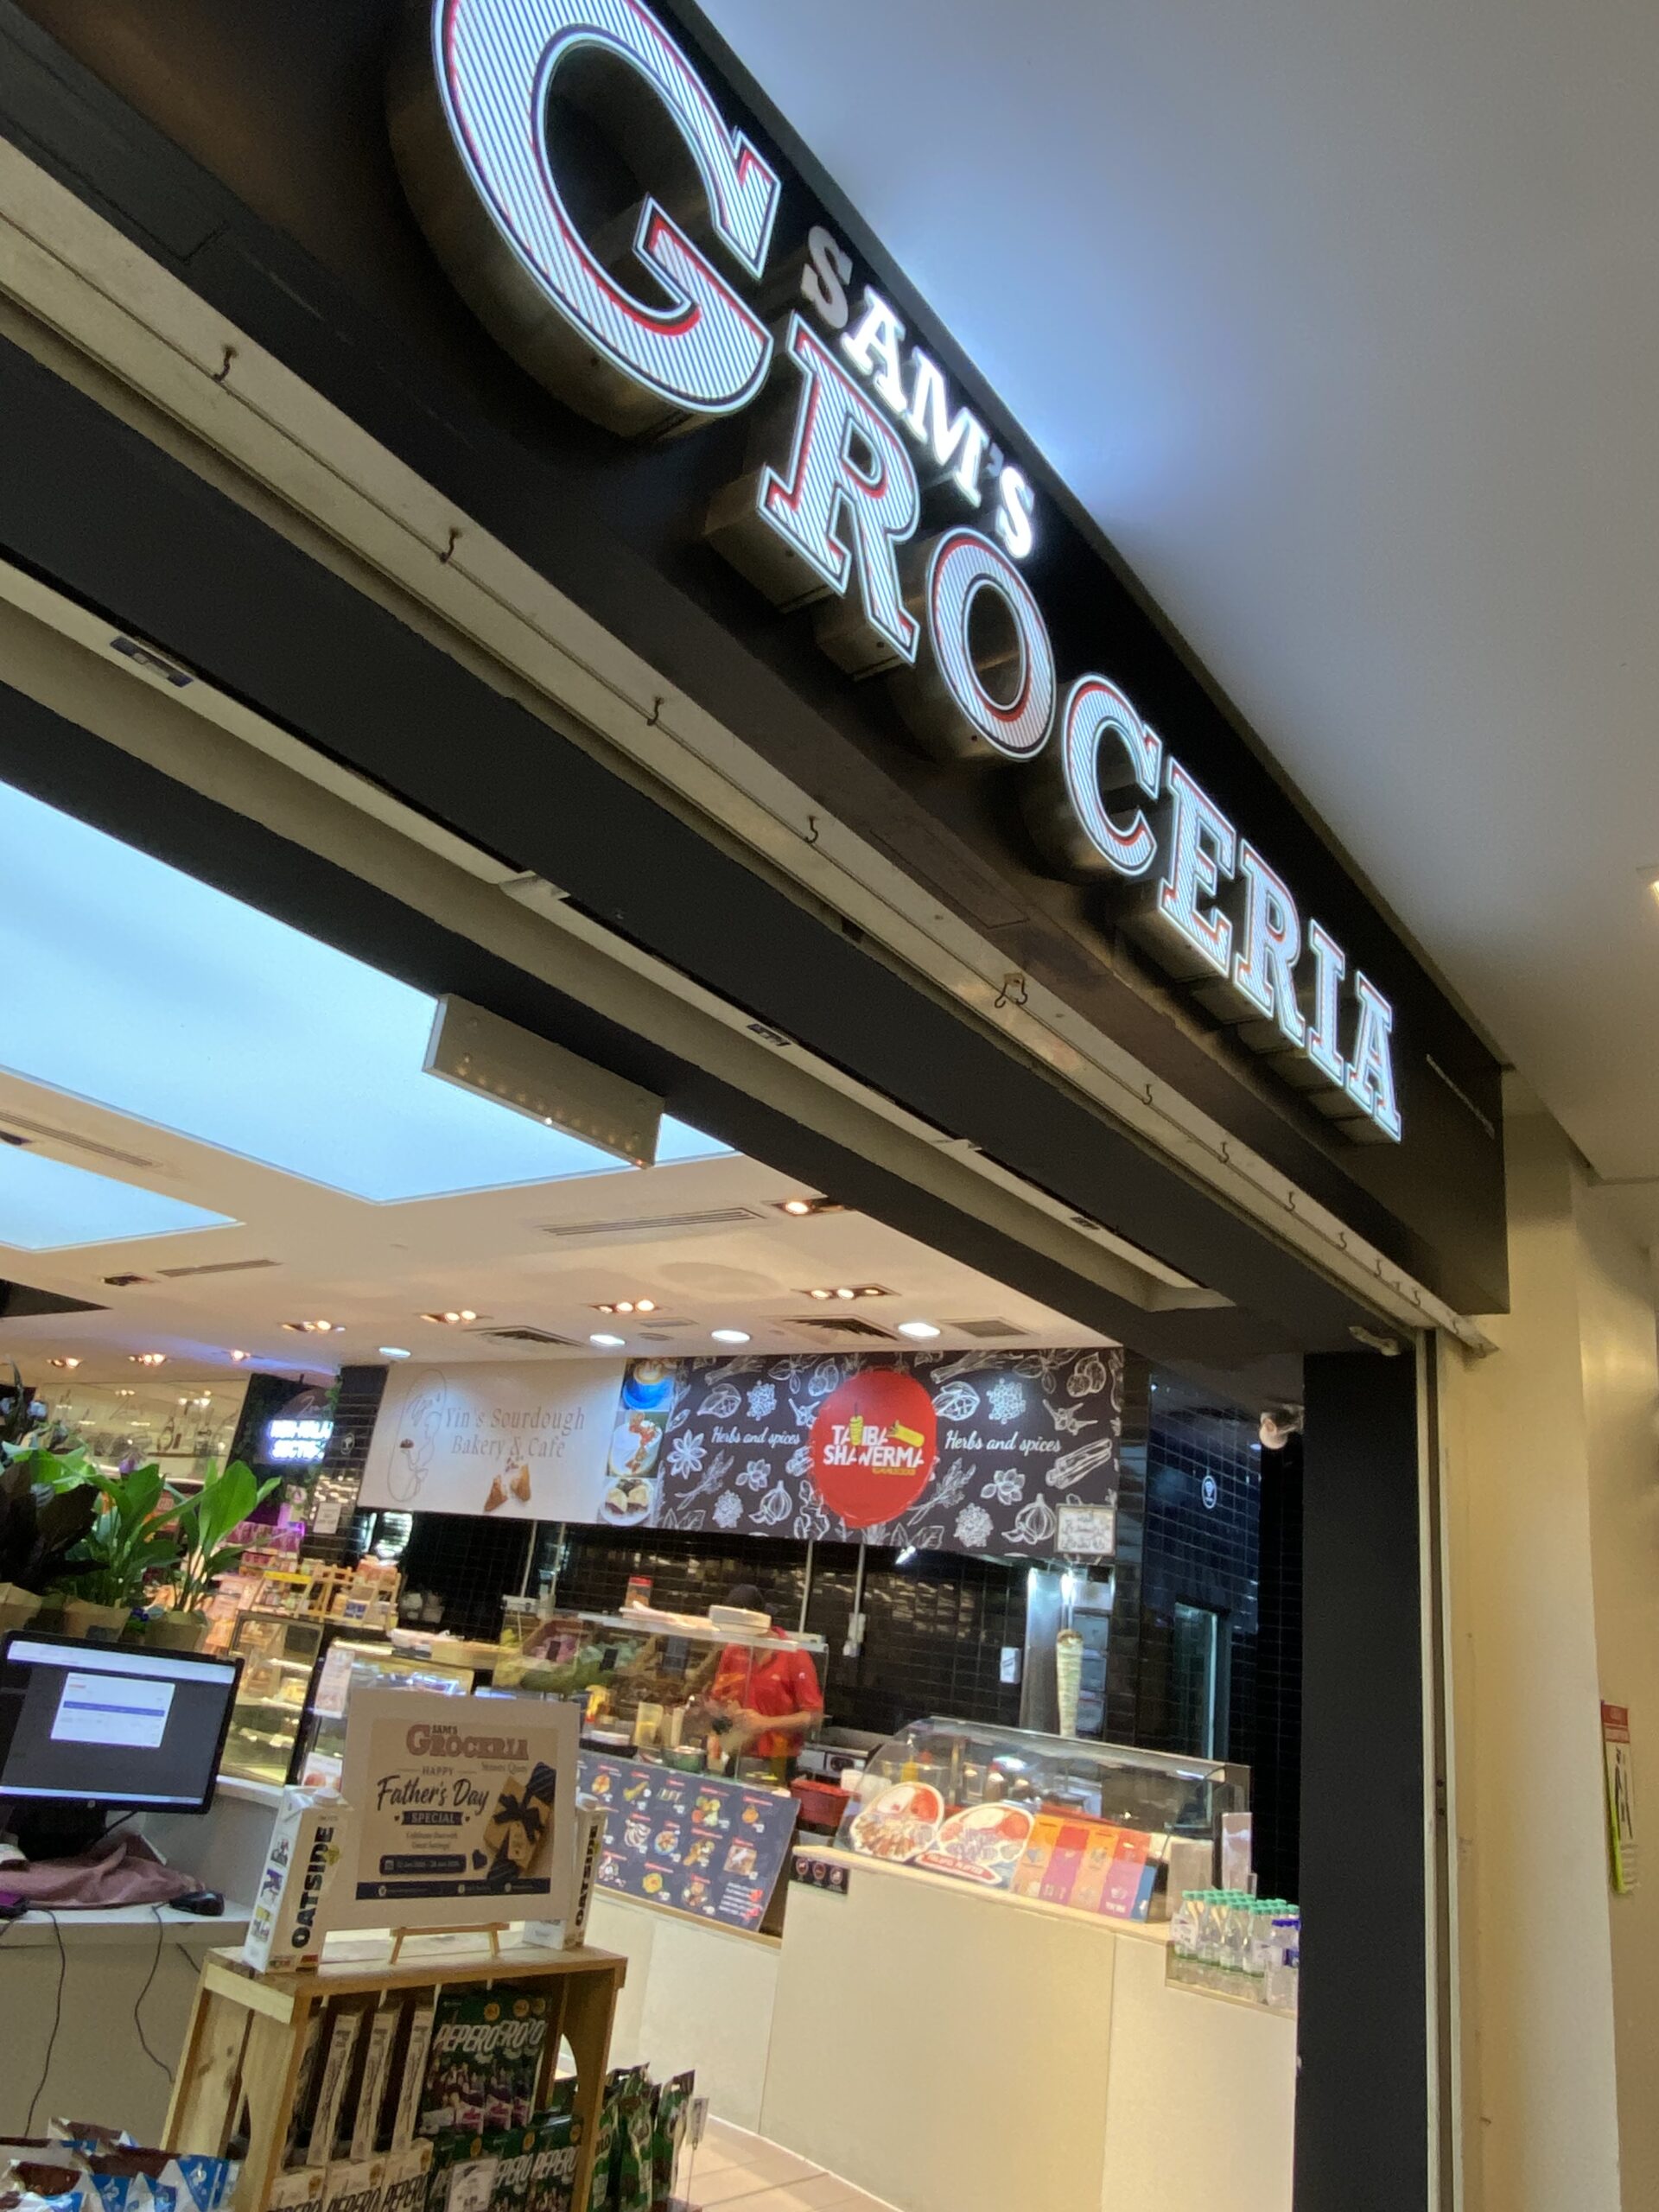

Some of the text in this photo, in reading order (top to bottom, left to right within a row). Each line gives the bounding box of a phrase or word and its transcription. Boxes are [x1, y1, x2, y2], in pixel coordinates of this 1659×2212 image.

[800, 226, 1035, 559] SAM'S
[429, 0, 1402, 1142] GROCERIA
[446, 1406, 585, 1437] Yin's Sourdough
[450, 1433, 505, 1461] Bakery
[711, 1426, 801, 1449] Herbs and spices
[944, 1429, 1062, 1457] Herbs and spices
[823, 1444, 925, 1468] SHAWERMA
[406, 1724, 529, 1760] GROCERIA
[422, 1766, 454, 1776] HAPPY
[377, 1775, 490, 1816] Father's Day
[410, 1813, 456, 1824] SPECIAL
[291, 1827, 335, 1948] OATSIDE
[432, 2024, 500, 2053] PEPERO
